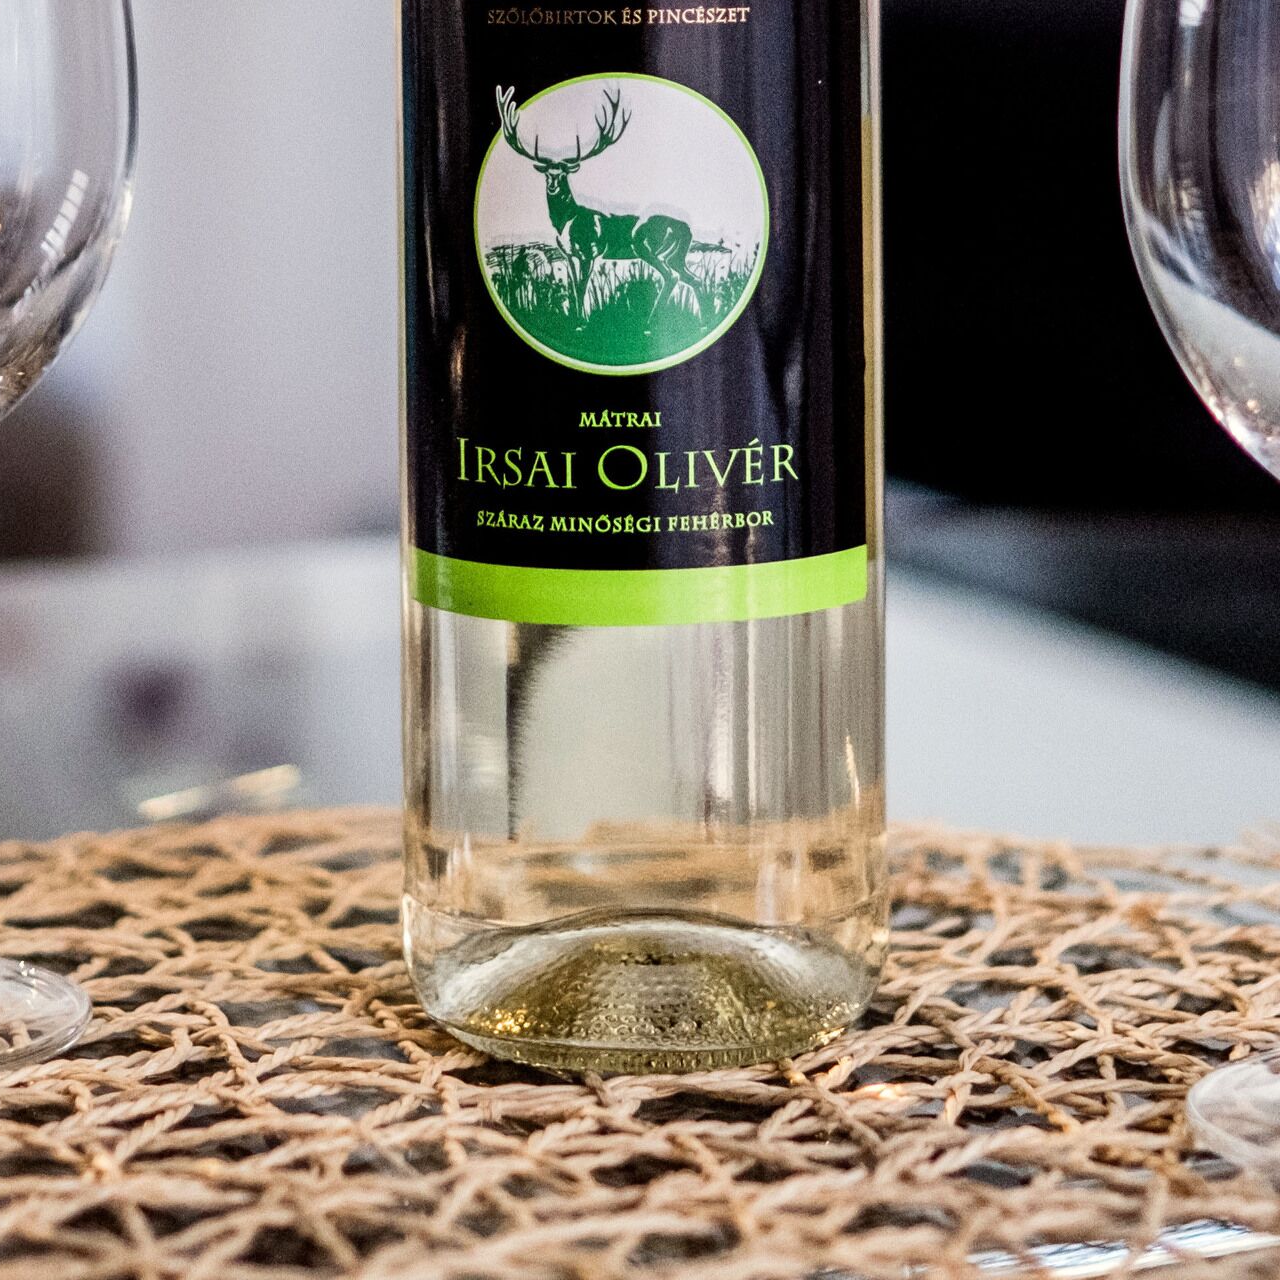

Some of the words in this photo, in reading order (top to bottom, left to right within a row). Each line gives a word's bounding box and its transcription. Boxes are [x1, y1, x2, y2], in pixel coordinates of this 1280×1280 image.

[487, 5, 618, 26] SZŐLŐBIRTOK
[621, 4, 642, 25] ÉS
[646, 5, 751, 25] PINCÉSZET
[578, 409, 662, 429] MÁTRAI
[455, 436, 579, 491] IRSAI
[596, 438, 799, 494] OLIVÉR
[476, 509, 545, 533] SZÁRAZ
[549, 512, 662, 535] MINŐSÉGI
[666, 509, 775, 532] FEHÉRBOR
